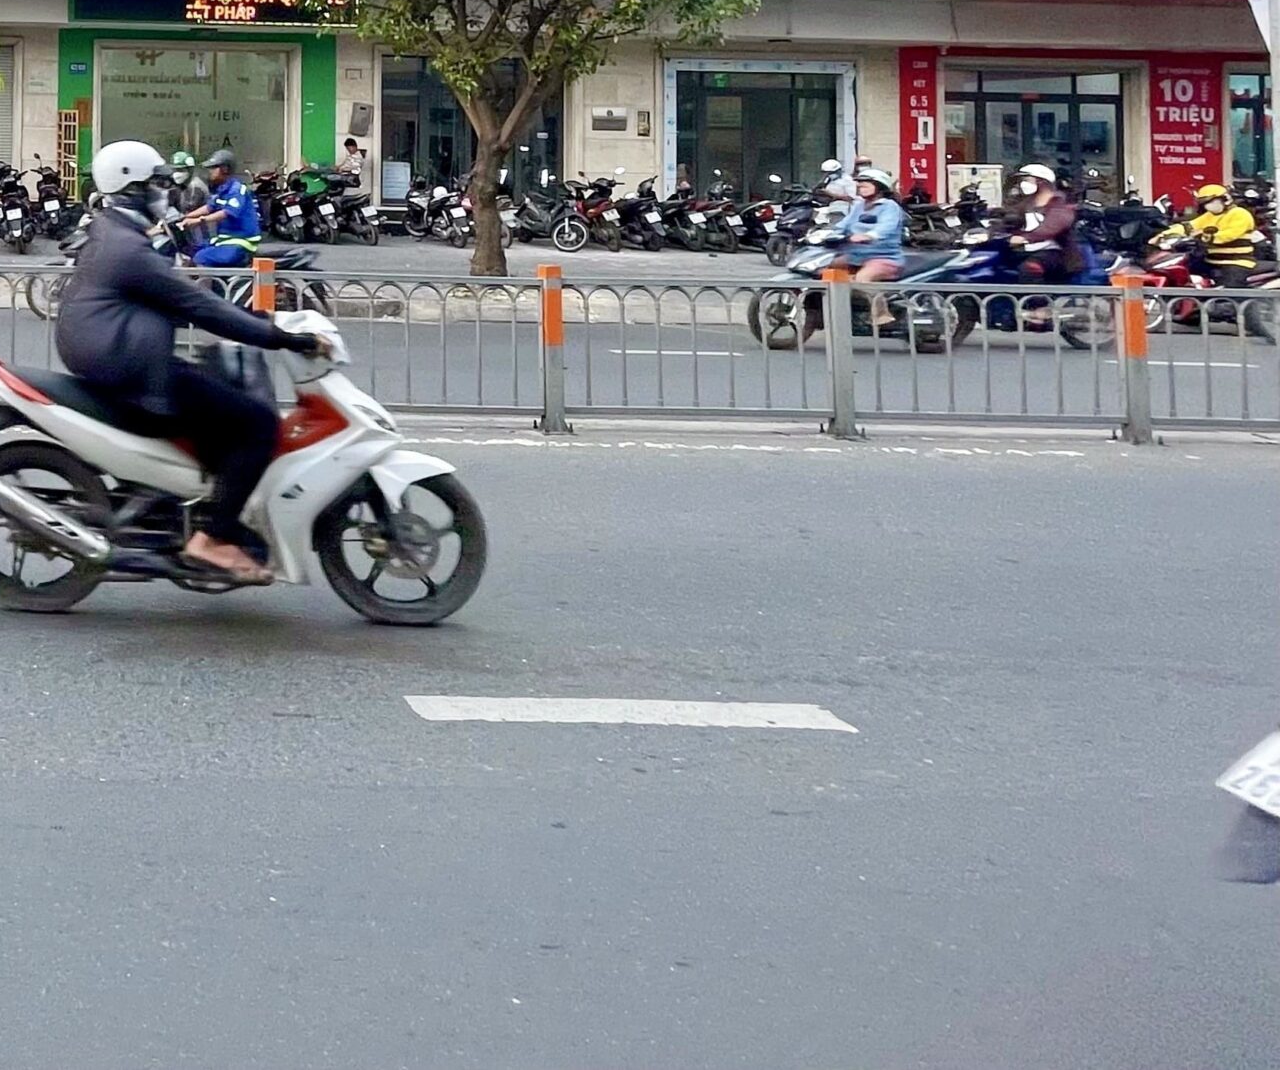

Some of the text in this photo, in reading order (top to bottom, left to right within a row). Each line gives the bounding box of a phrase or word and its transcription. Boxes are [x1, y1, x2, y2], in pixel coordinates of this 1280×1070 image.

[214, 3, 256, 20] PHÁP
[1159, 79, 1194, 102] 10
[910, 95, 928, 107] 6.5
[1155, 104, 1215, 127] TRIỆU
